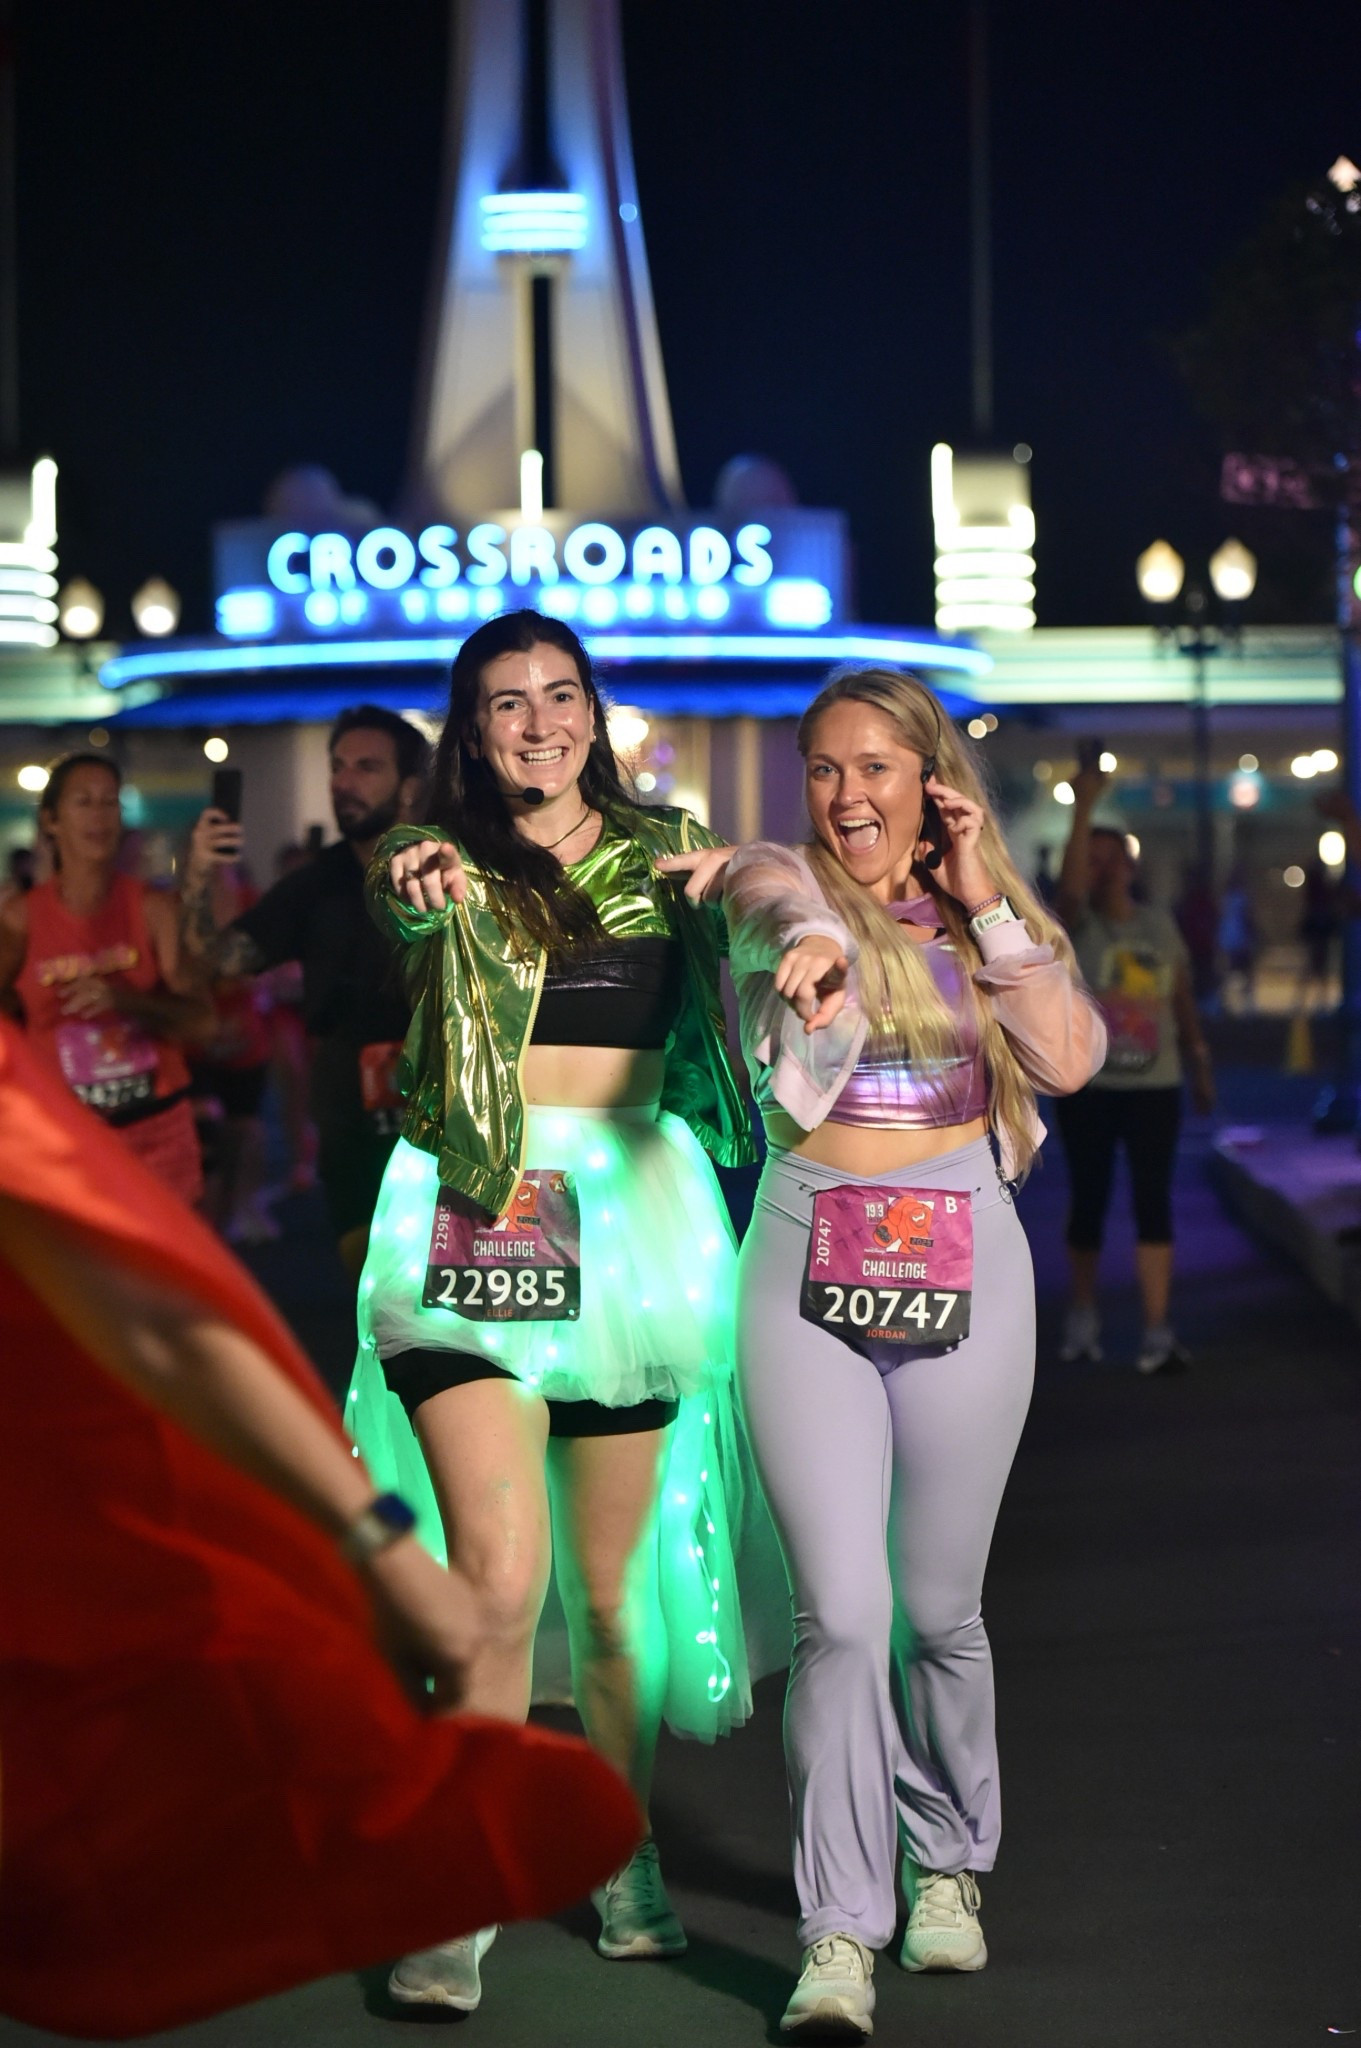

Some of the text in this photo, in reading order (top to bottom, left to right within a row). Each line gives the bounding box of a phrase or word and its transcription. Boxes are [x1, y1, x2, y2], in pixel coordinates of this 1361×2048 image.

[267, 523, 773, 594] CROSSROADS
[945, 1196, 958, 1214] B
[473, 1241, 535, 1257] CHALLENGE
[816, 1218, 832, 1266] 20747
[862, 1260, 927, 1279] CHALLENGE
[437, 1269, 566, 1306] 22985
[822, 1286, 958, 1330] 20747
[866, 1329, 906, 1340] JORDAN
